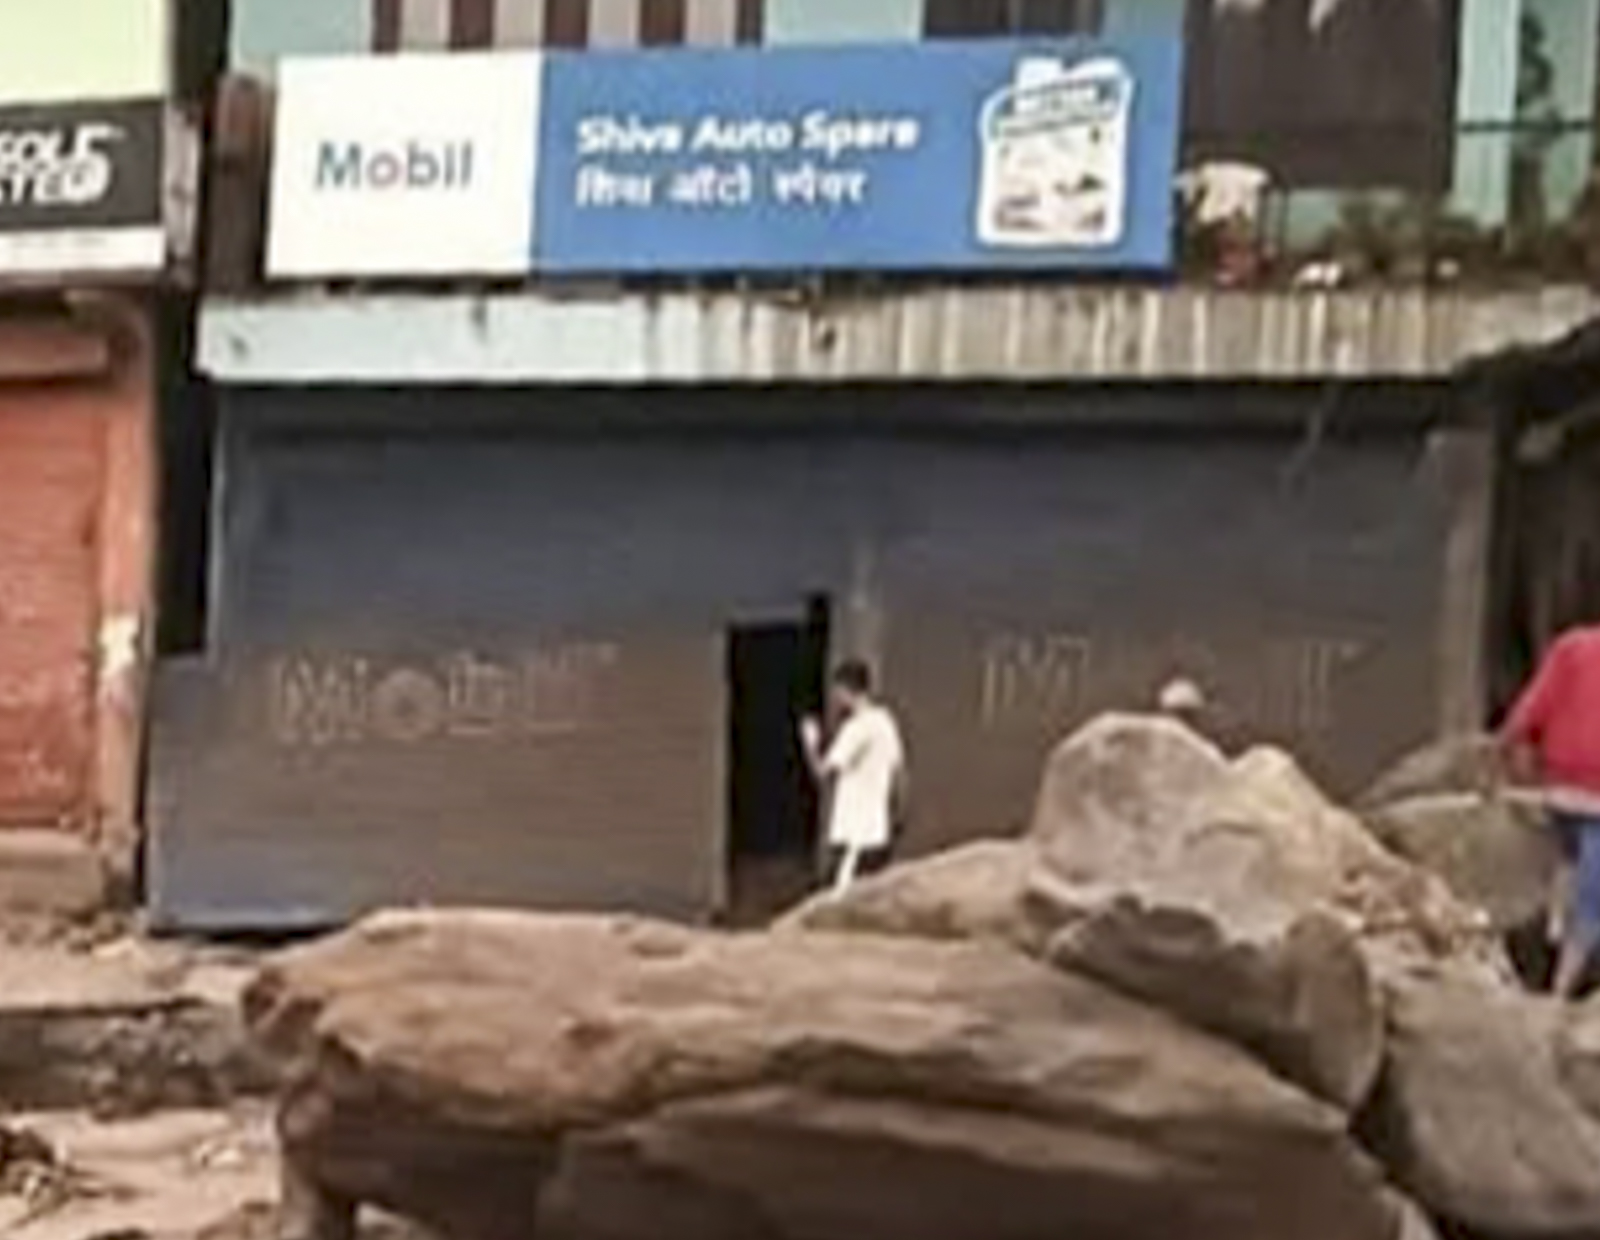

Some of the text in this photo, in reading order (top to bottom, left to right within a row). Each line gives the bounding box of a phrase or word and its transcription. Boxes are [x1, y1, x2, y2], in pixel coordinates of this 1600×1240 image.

[577, 110, 920, 160] Shiva Auto Spare
[315, 137, 474, 190] Mobil
